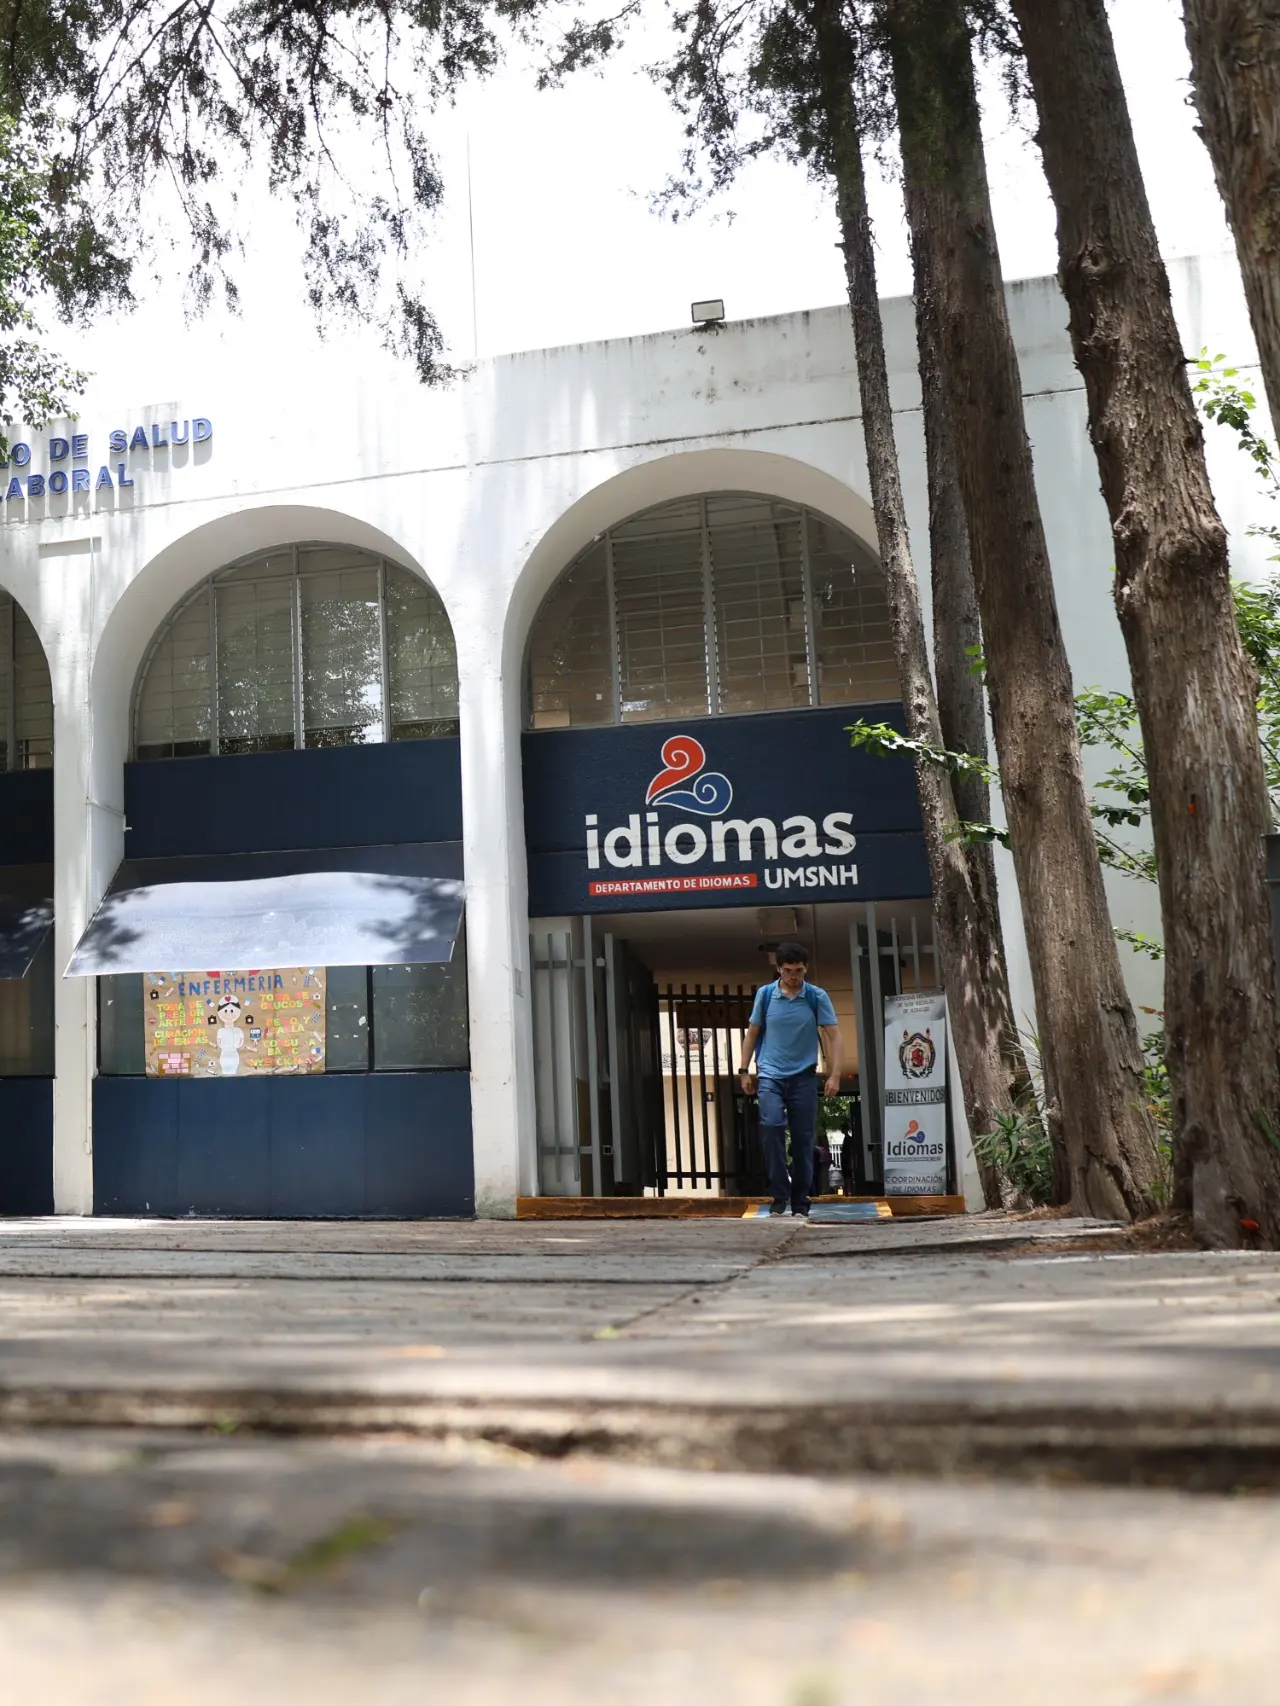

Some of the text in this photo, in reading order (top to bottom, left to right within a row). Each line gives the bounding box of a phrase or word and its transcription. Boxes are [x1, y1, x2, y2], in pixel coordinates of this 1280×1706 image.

[49, 434, 89, 462] DE
[109, 417, 214, 455] SALUD
[585, 812, 857, 869] idiomas
[595, 875, 751, 893] DEPARTAMENTO DE IDIOMAS
[764, 864, 859, 890] UMSNH
[178, 975, 283, 996] ENFERMERIA
[156, 1002, 185, 1012] TOMA
[263, 1038, 316, 1048] COSUA
[886, 1140, 944, 1157] Idiomas
[885, 1175, 943, 1184] COORDINACIÓN
[904, 1185, 937, 1193] IDIOMAS
